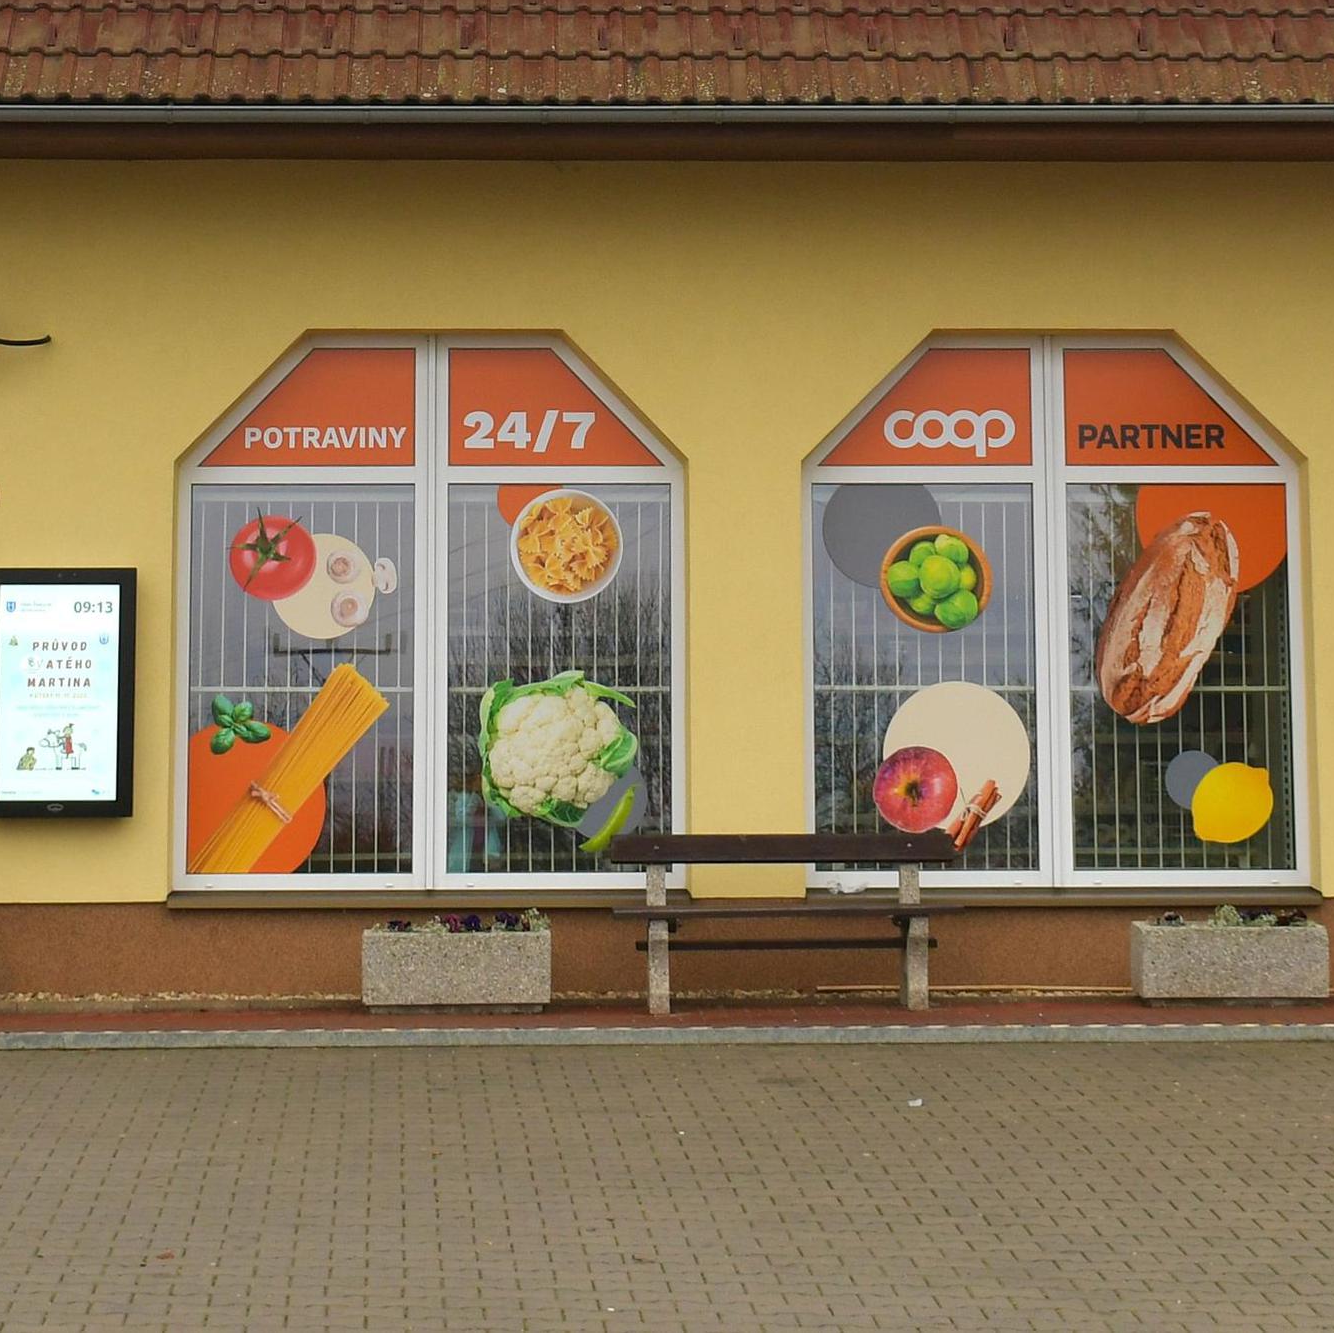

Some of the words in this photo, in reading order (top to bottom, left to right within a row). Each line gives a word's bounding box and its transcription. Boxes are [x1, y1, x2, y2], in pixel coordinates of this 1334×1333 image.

[244, 426, 407, 450] POTRAVINY
[463, 409, 596, 453] 24/7
[884, 409, 1015, 458] coop
[1078, 424, 1225, 450] PARTNER
[73, 601, 113, 614] 09:13
[32, 638, 88, 651] PRŮVOD
[28, 677, 91, 688] MARTINA
